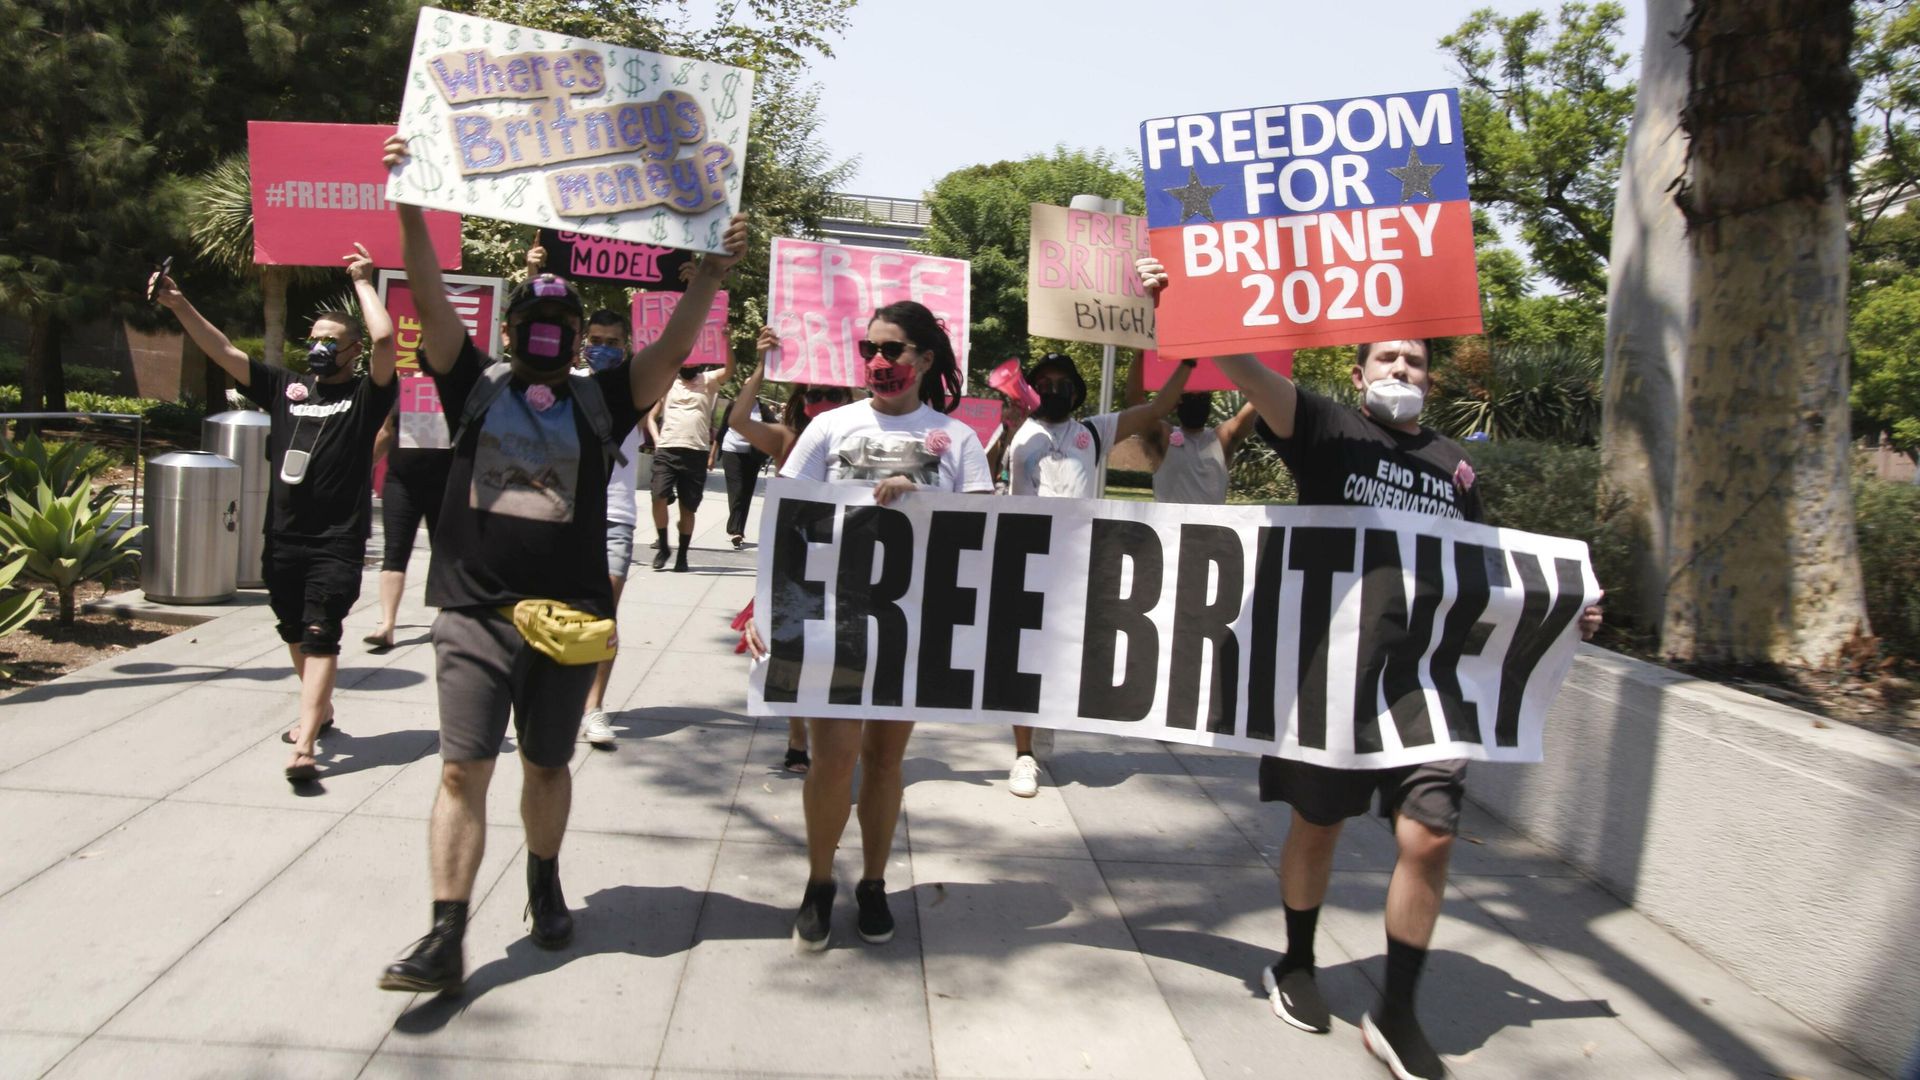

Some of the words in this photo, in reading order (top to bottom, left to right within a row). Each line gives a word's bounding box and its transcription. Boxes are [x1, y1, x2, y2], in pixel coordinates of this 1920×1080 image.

[432, 50, 603, 97] Where's
[454, 92, 701, 170] Britney's
[1146, 93, 1453, 169] FREEDOM
[265, 181, 396, 211] #FREEBRI
[555, 145, 729, 209] money?
[1243, 154, 1375, 214] FOR
[572, 247, 661, 278] MODEL
[1038, 240, 1146, 297] BRITN
[1183, 203, 1442, 277] BRITNEY
[1241, 263, 1404, 327] 2020
[1376, 459, 1414, 489] END
[1420, 472, 1455, 503] THE
[763, 497, 1053, 714] FREE
[1078, 518, 1584, 756] BRITNEY
